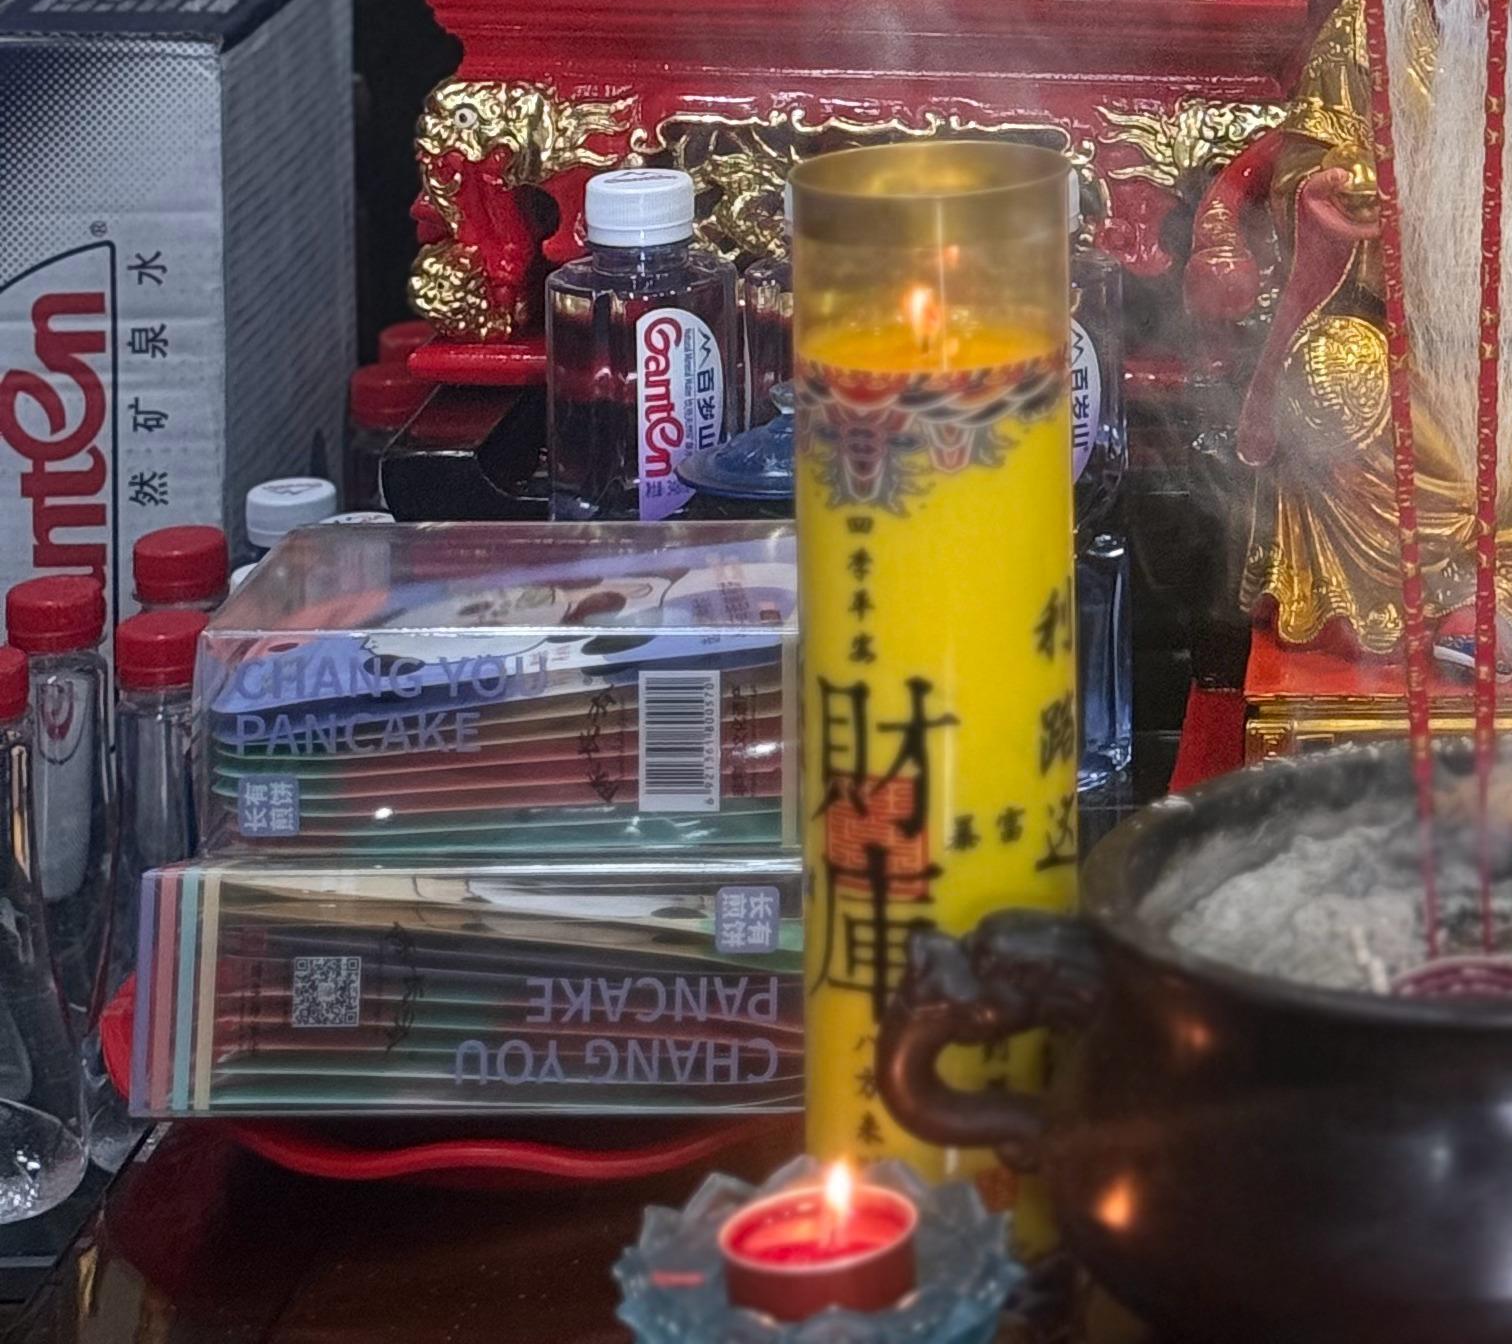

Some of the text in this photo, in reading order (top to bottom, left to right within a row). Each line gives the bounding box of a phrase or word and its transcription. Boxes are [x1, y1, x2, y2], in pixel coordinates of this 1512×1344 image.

[234, 656, 550, 699] CHANG YOU
[236, 712, 482, 755] PANCAKE
[526, 976, 779, 1023] PANCAKE
[454, 1037, 779, 1086] CHANG YOU
